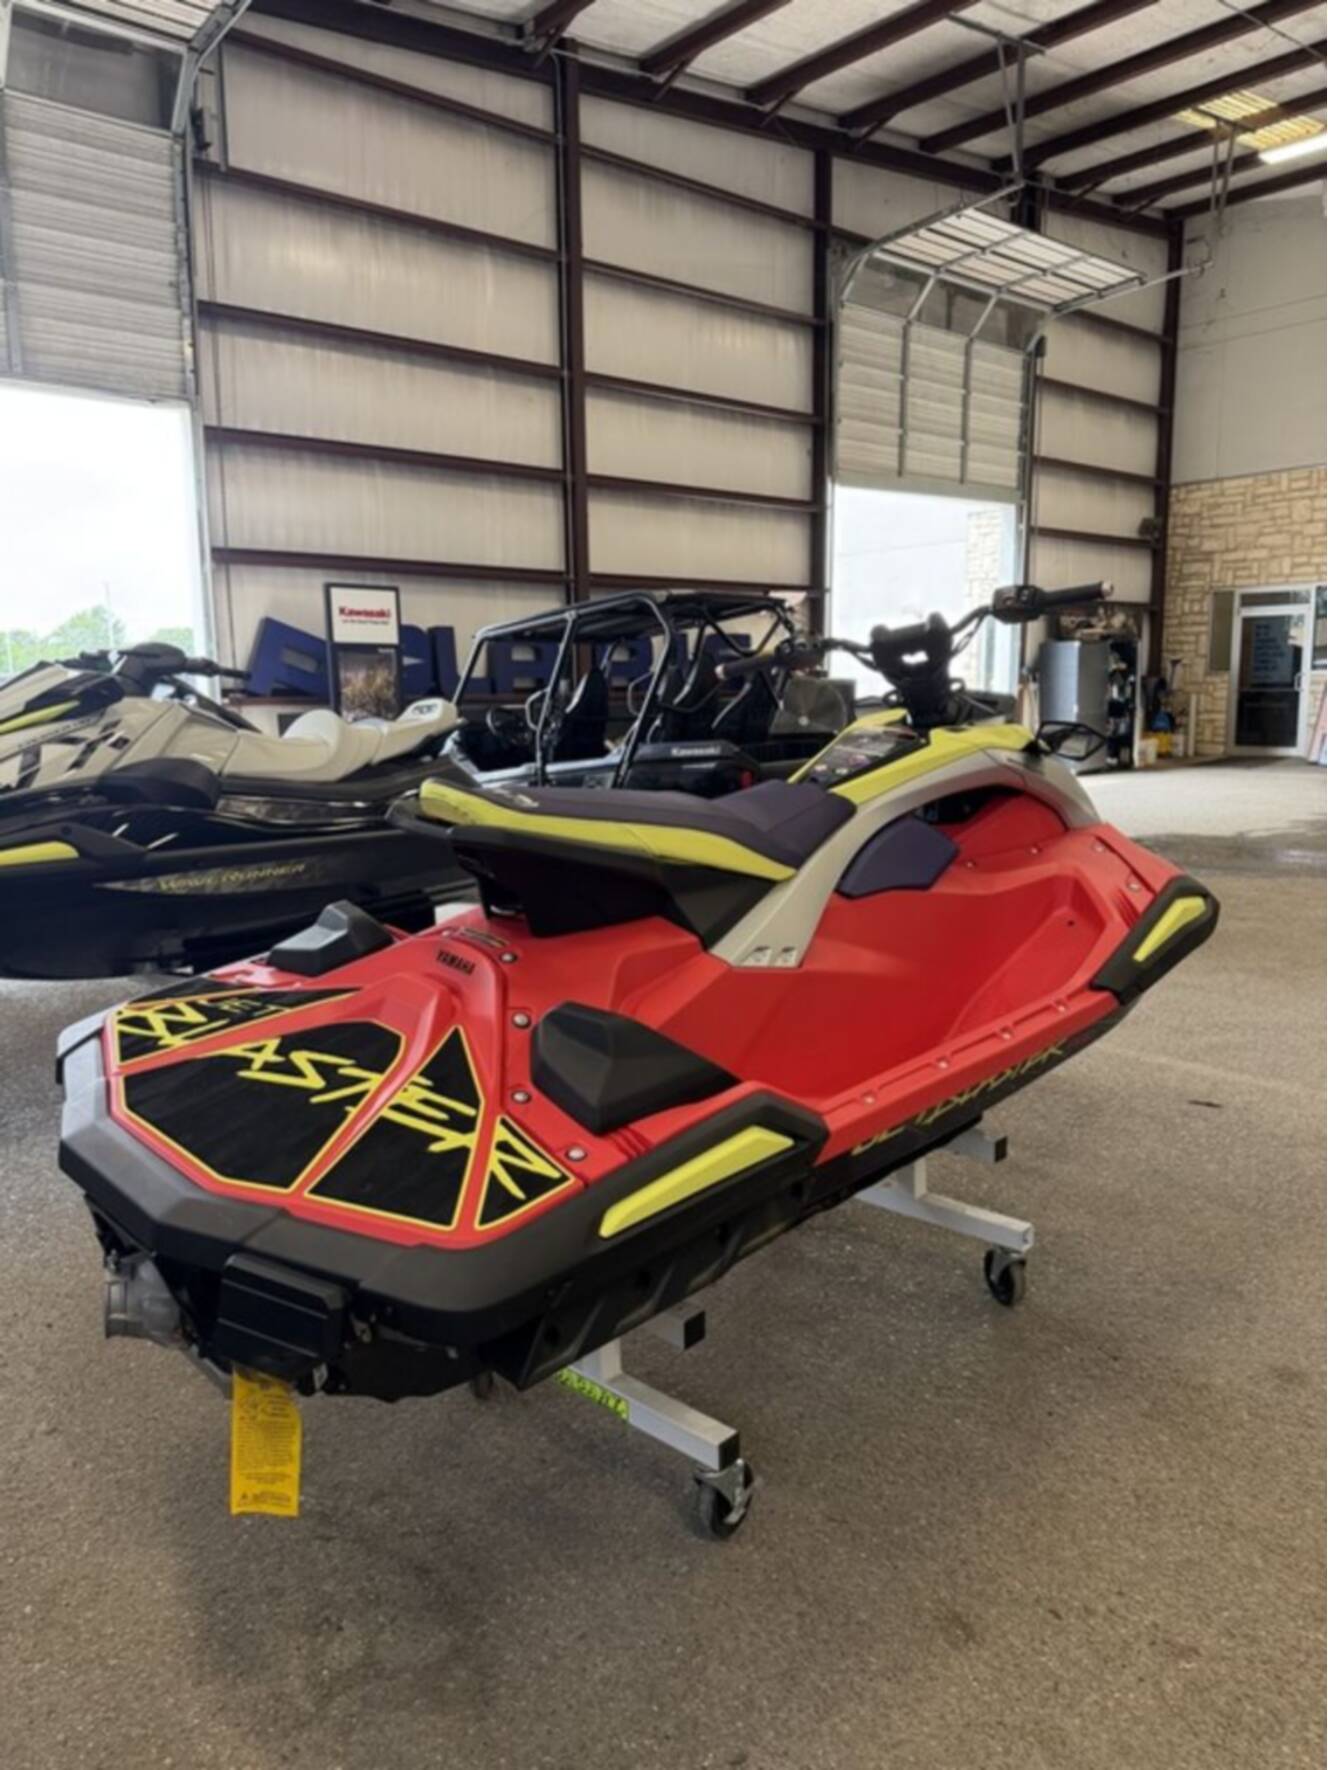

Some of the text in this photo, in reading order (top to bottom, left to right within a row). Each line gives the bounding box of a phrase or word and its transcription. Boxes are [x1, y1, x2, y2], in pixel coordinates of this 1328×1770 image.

[338, 606, 391, 618] Kawasaki
[671, 747, 721, 757] Kawasaki
[437, 950, 475, 976] YAMAHA
